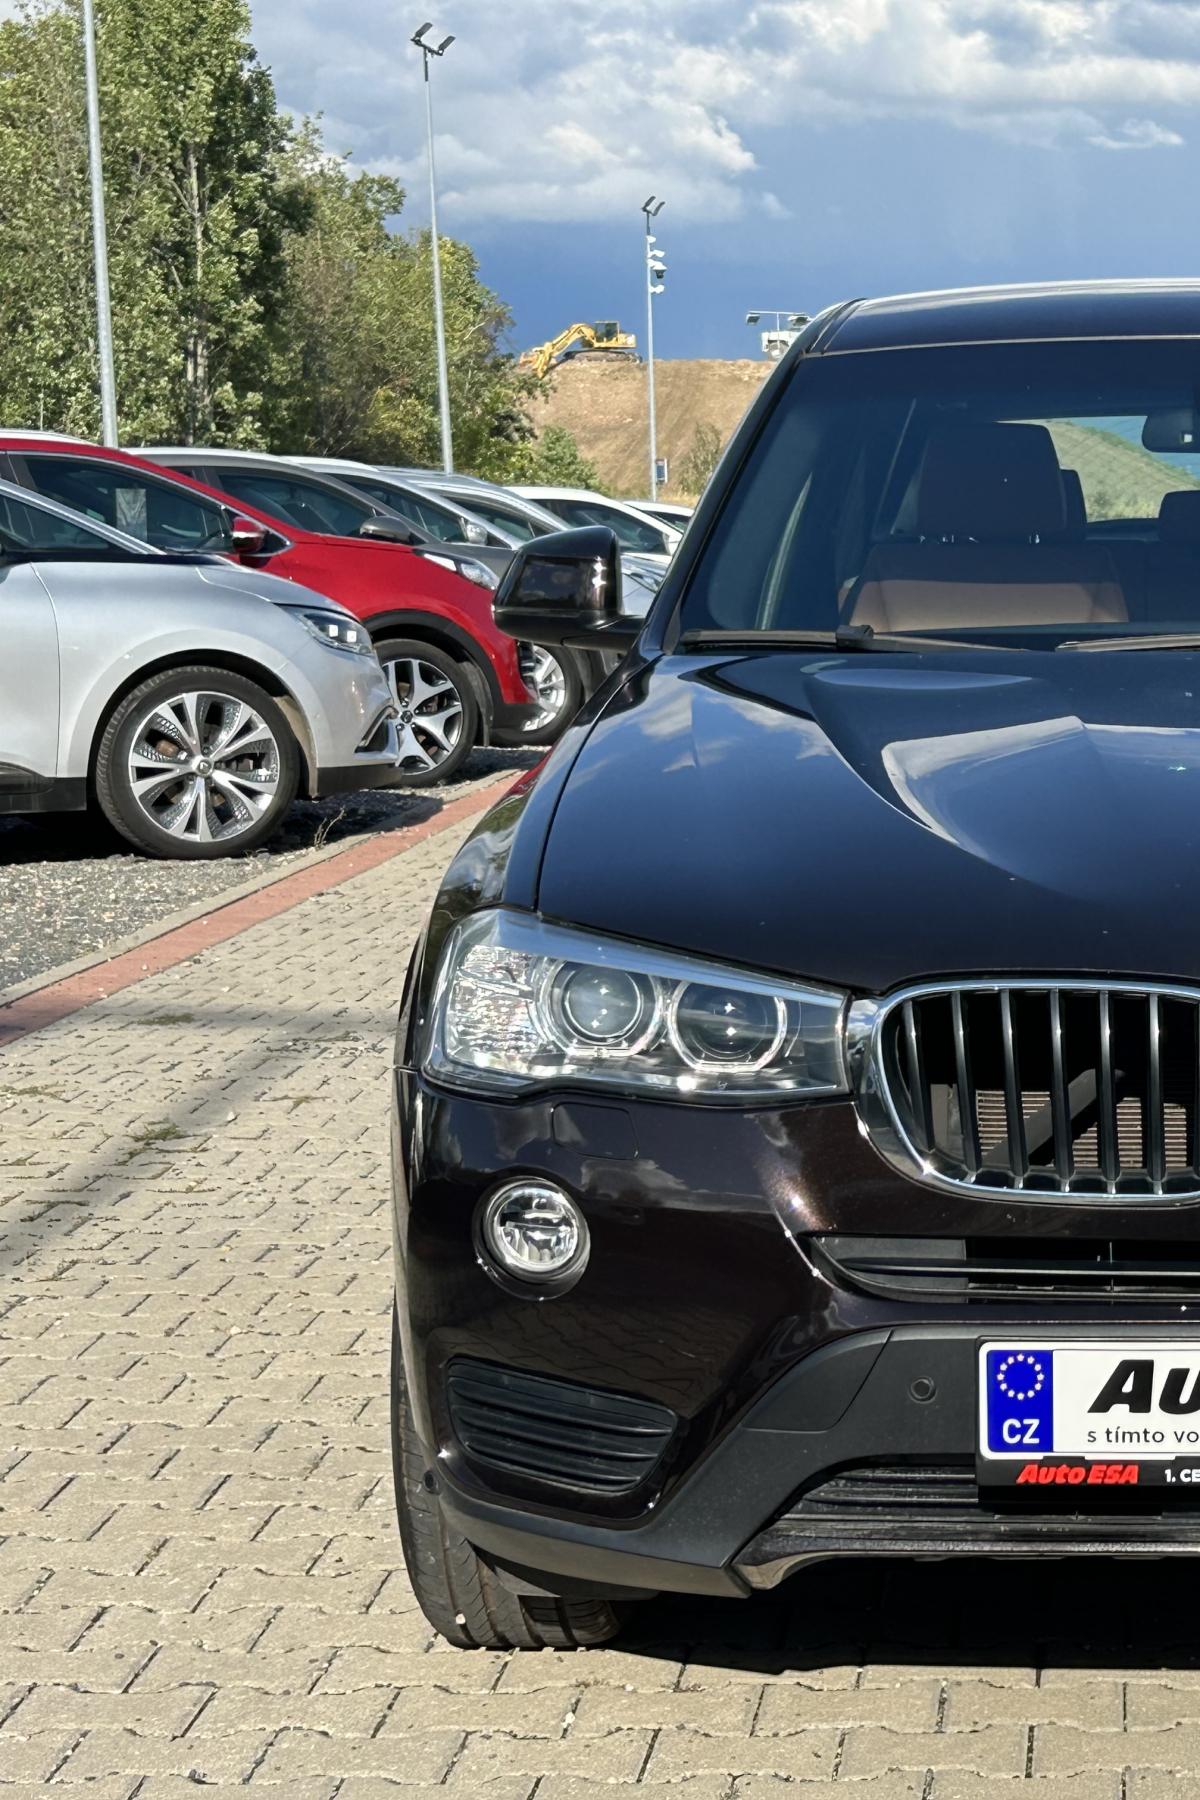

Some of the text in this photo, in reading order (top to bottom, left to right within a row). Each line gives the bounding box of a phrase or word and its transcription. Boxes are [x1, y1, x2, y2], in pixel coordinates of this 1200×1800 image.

[1002, 1418, 1040, 1445] CZ
[1087, 1430, 1097, 1443] s
[1105, 1426, 1165, 1443] tímto
[1016, 1463, 1139, 1484] Auto ESA
[1164, 1468, 1176, 1483] 1.
